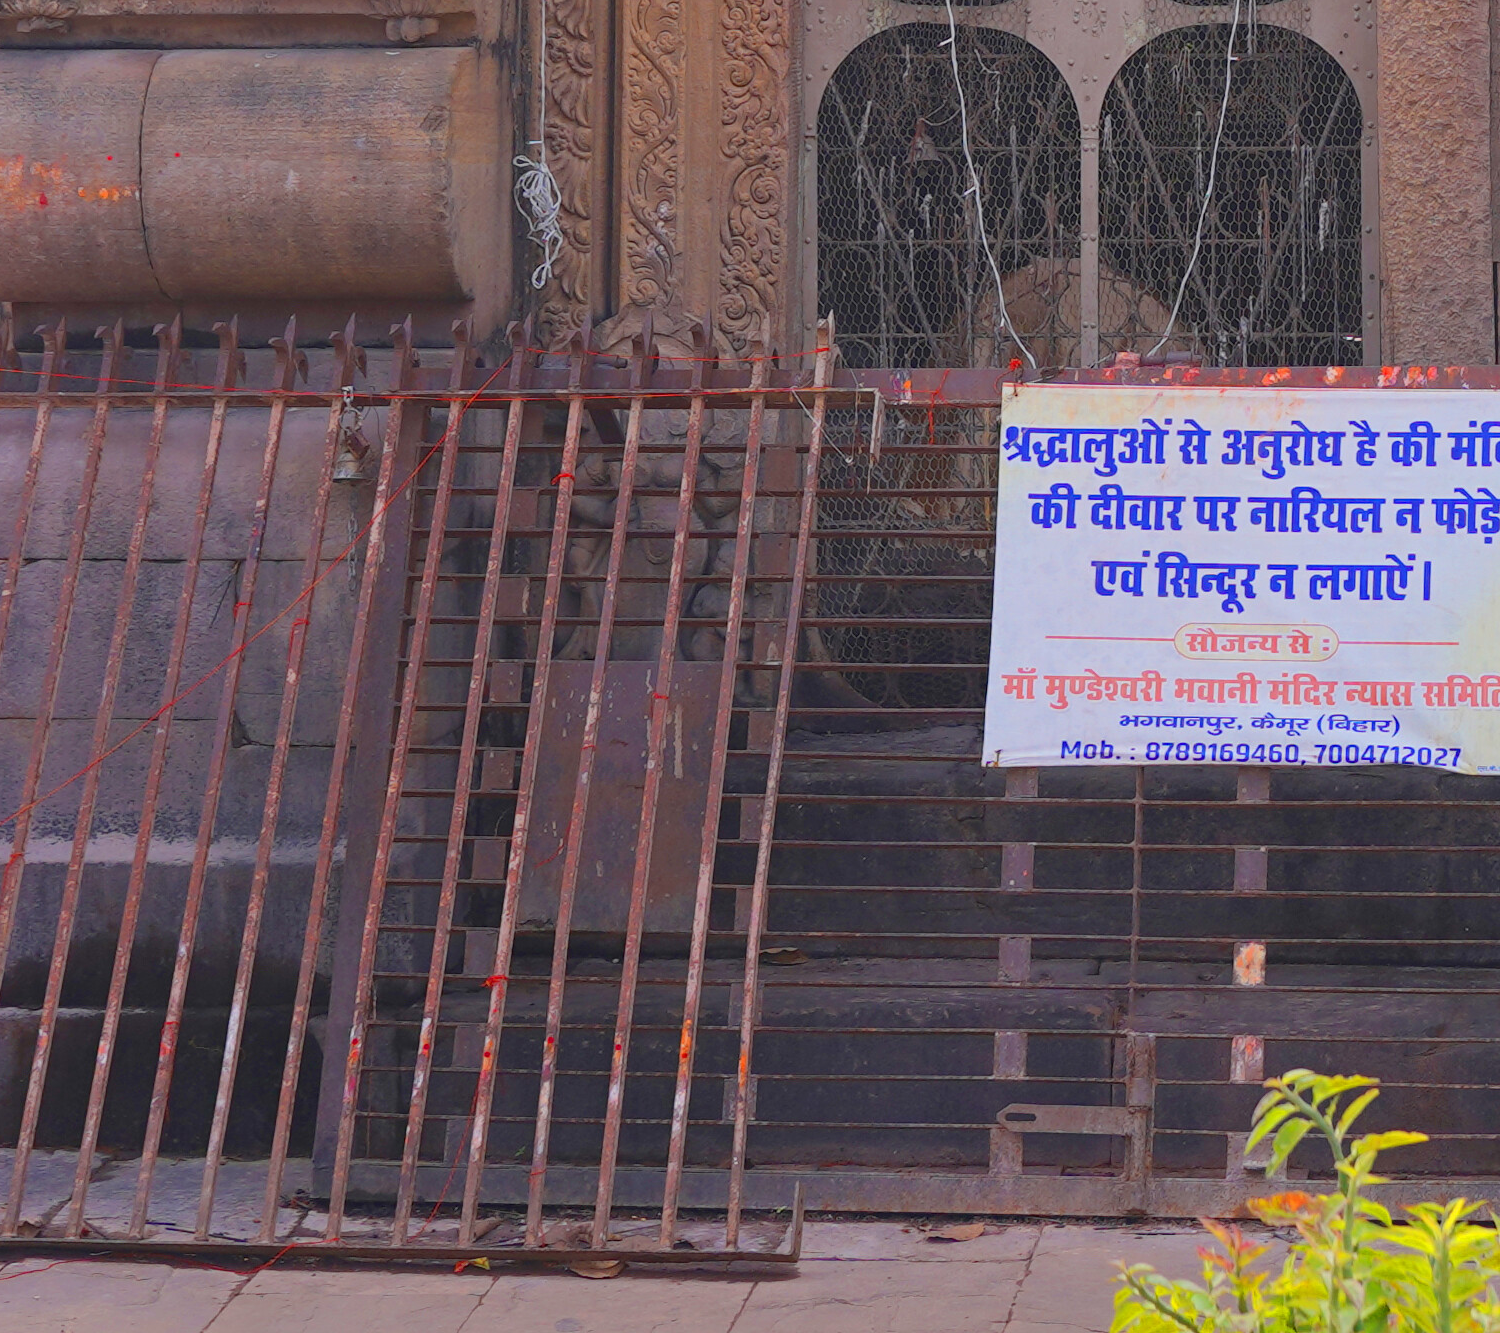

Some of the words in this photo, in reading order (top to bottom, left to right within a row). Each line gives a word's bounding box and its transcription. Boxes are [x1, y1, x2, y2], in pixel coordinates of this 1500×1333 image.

[1002, 418, 1172, 477] श्रद्धालुओं
[1176, 419, 1212, 464] से
[1221, 420, 1346, 480] अनुरोध
[1348, 419, 1380, 466] है
[1387, 420, 1442, 467] की
[1028, 483, 1082, 529] की
[1087, 484, 1187, 531] दीवार
[1193, 495, 1241, 532] पर
[1247, 486, 1386, 533] नारियल
[1393, 497, 1426, 534] न
[1090, 550, 1151, 597] एवं
[1154, 550, 1261, 613] सिन्दूर
[1267, 564, 1299, 600] न
[1185, 627, 1283, 653] सौजन्य
[1286, 629, 1313, 654] से
[1043, 668, 1167, 710] मुण्डेश्वरी
[1174, 671, 1262, 705] भवानी
[1267, 672, 1338, 706] मंदिर
[1344, 680, 1416, 707] न्यास
[1119, 714, 1243, 736] भगवानपुर,
[1251, 712, 1311, 737] कैमूर
[1314, 743, 1462, 767] 7004712027
